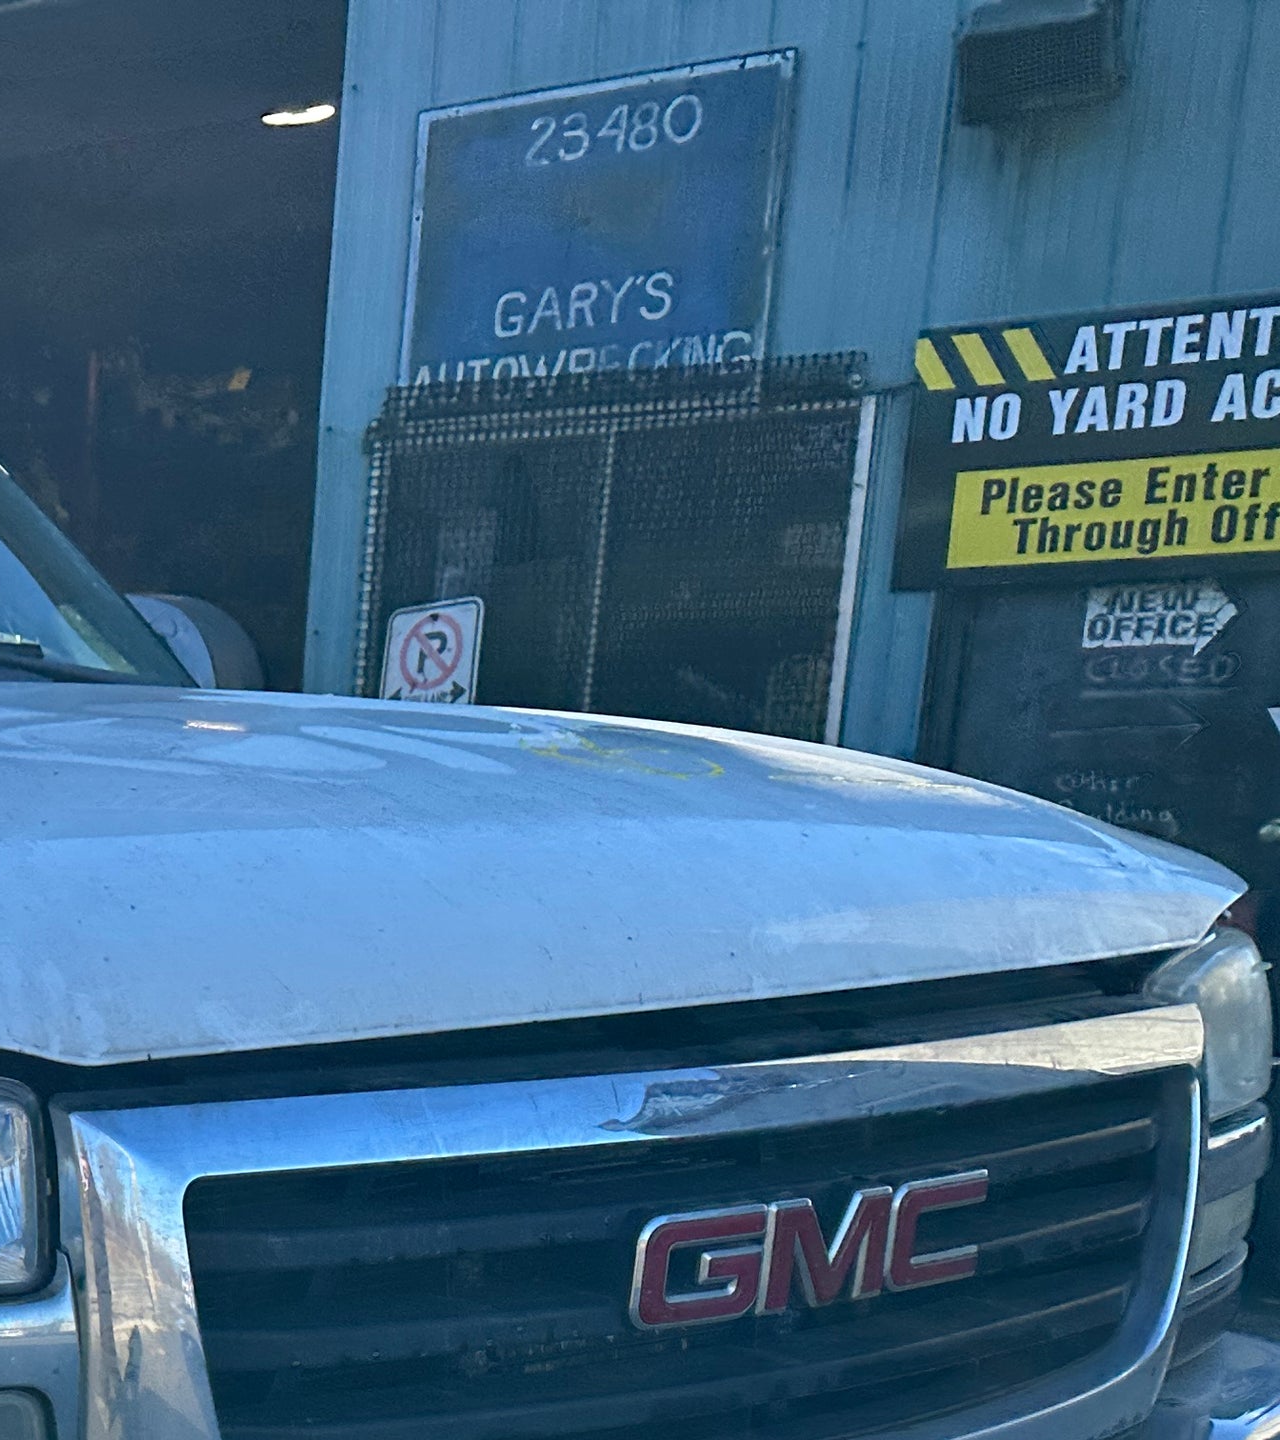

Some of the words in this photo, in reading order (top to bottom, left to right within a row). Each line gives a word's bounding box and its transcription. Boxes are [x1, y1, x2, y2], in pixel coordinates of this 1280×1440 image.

[526, 93, 704, 166] 23480
[493, 270, 675, 340] GARY'S
[1063, 306, 1280, 375] ATTENT
[951, 392, 1022, 444] NO
[1048, 379, 1187, 436] YARD
[1209, 368, 1280, 422] AC
[980, 476, 1123, 516] Please
[1144, 461, 1271, 505] Enter
[1012, 508, 1189, 555] Through
[1210, 502, 1280, 544] Off
[1087, 610, 1218, 642] OFFICE
[629, 1168, 989, 1331] GMC
